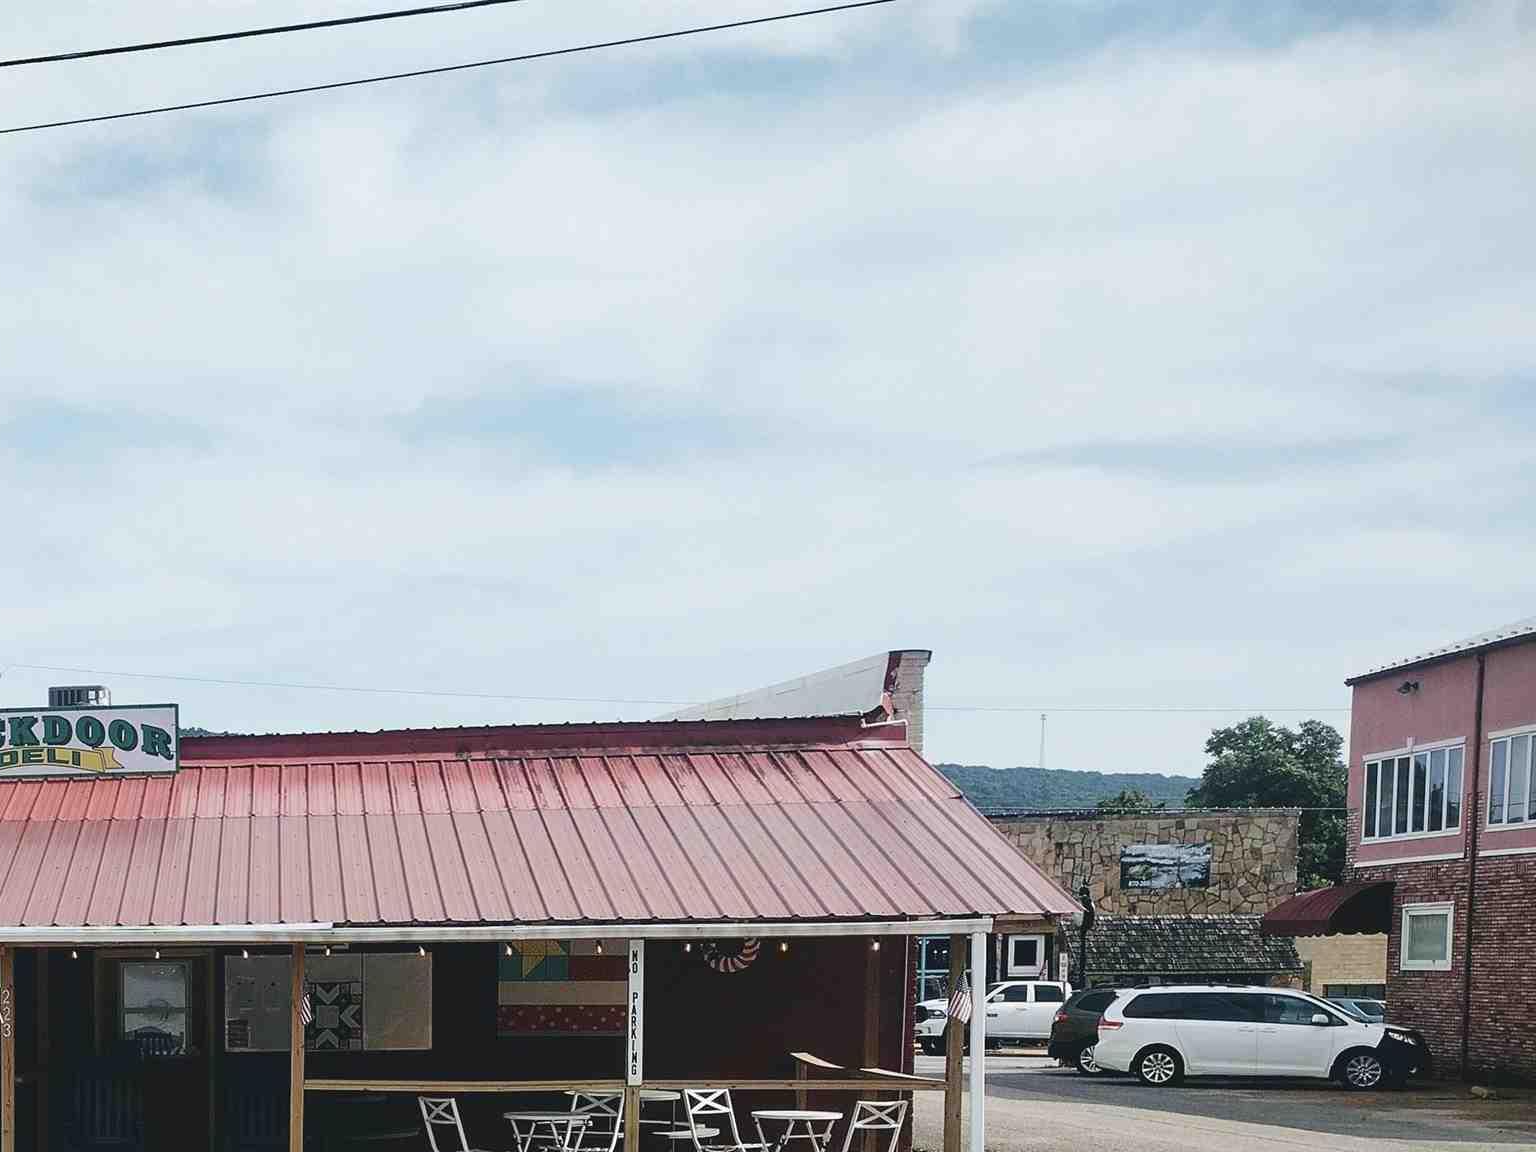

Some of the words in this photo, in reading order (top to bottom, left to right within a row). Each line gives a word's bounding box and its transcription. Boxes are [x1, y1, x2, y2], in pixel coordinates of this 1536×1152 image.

[631, 950, 639, 974] NO
[2, 989, 12, 1038] 223
[631, 992, 639, 1076] PARKING
